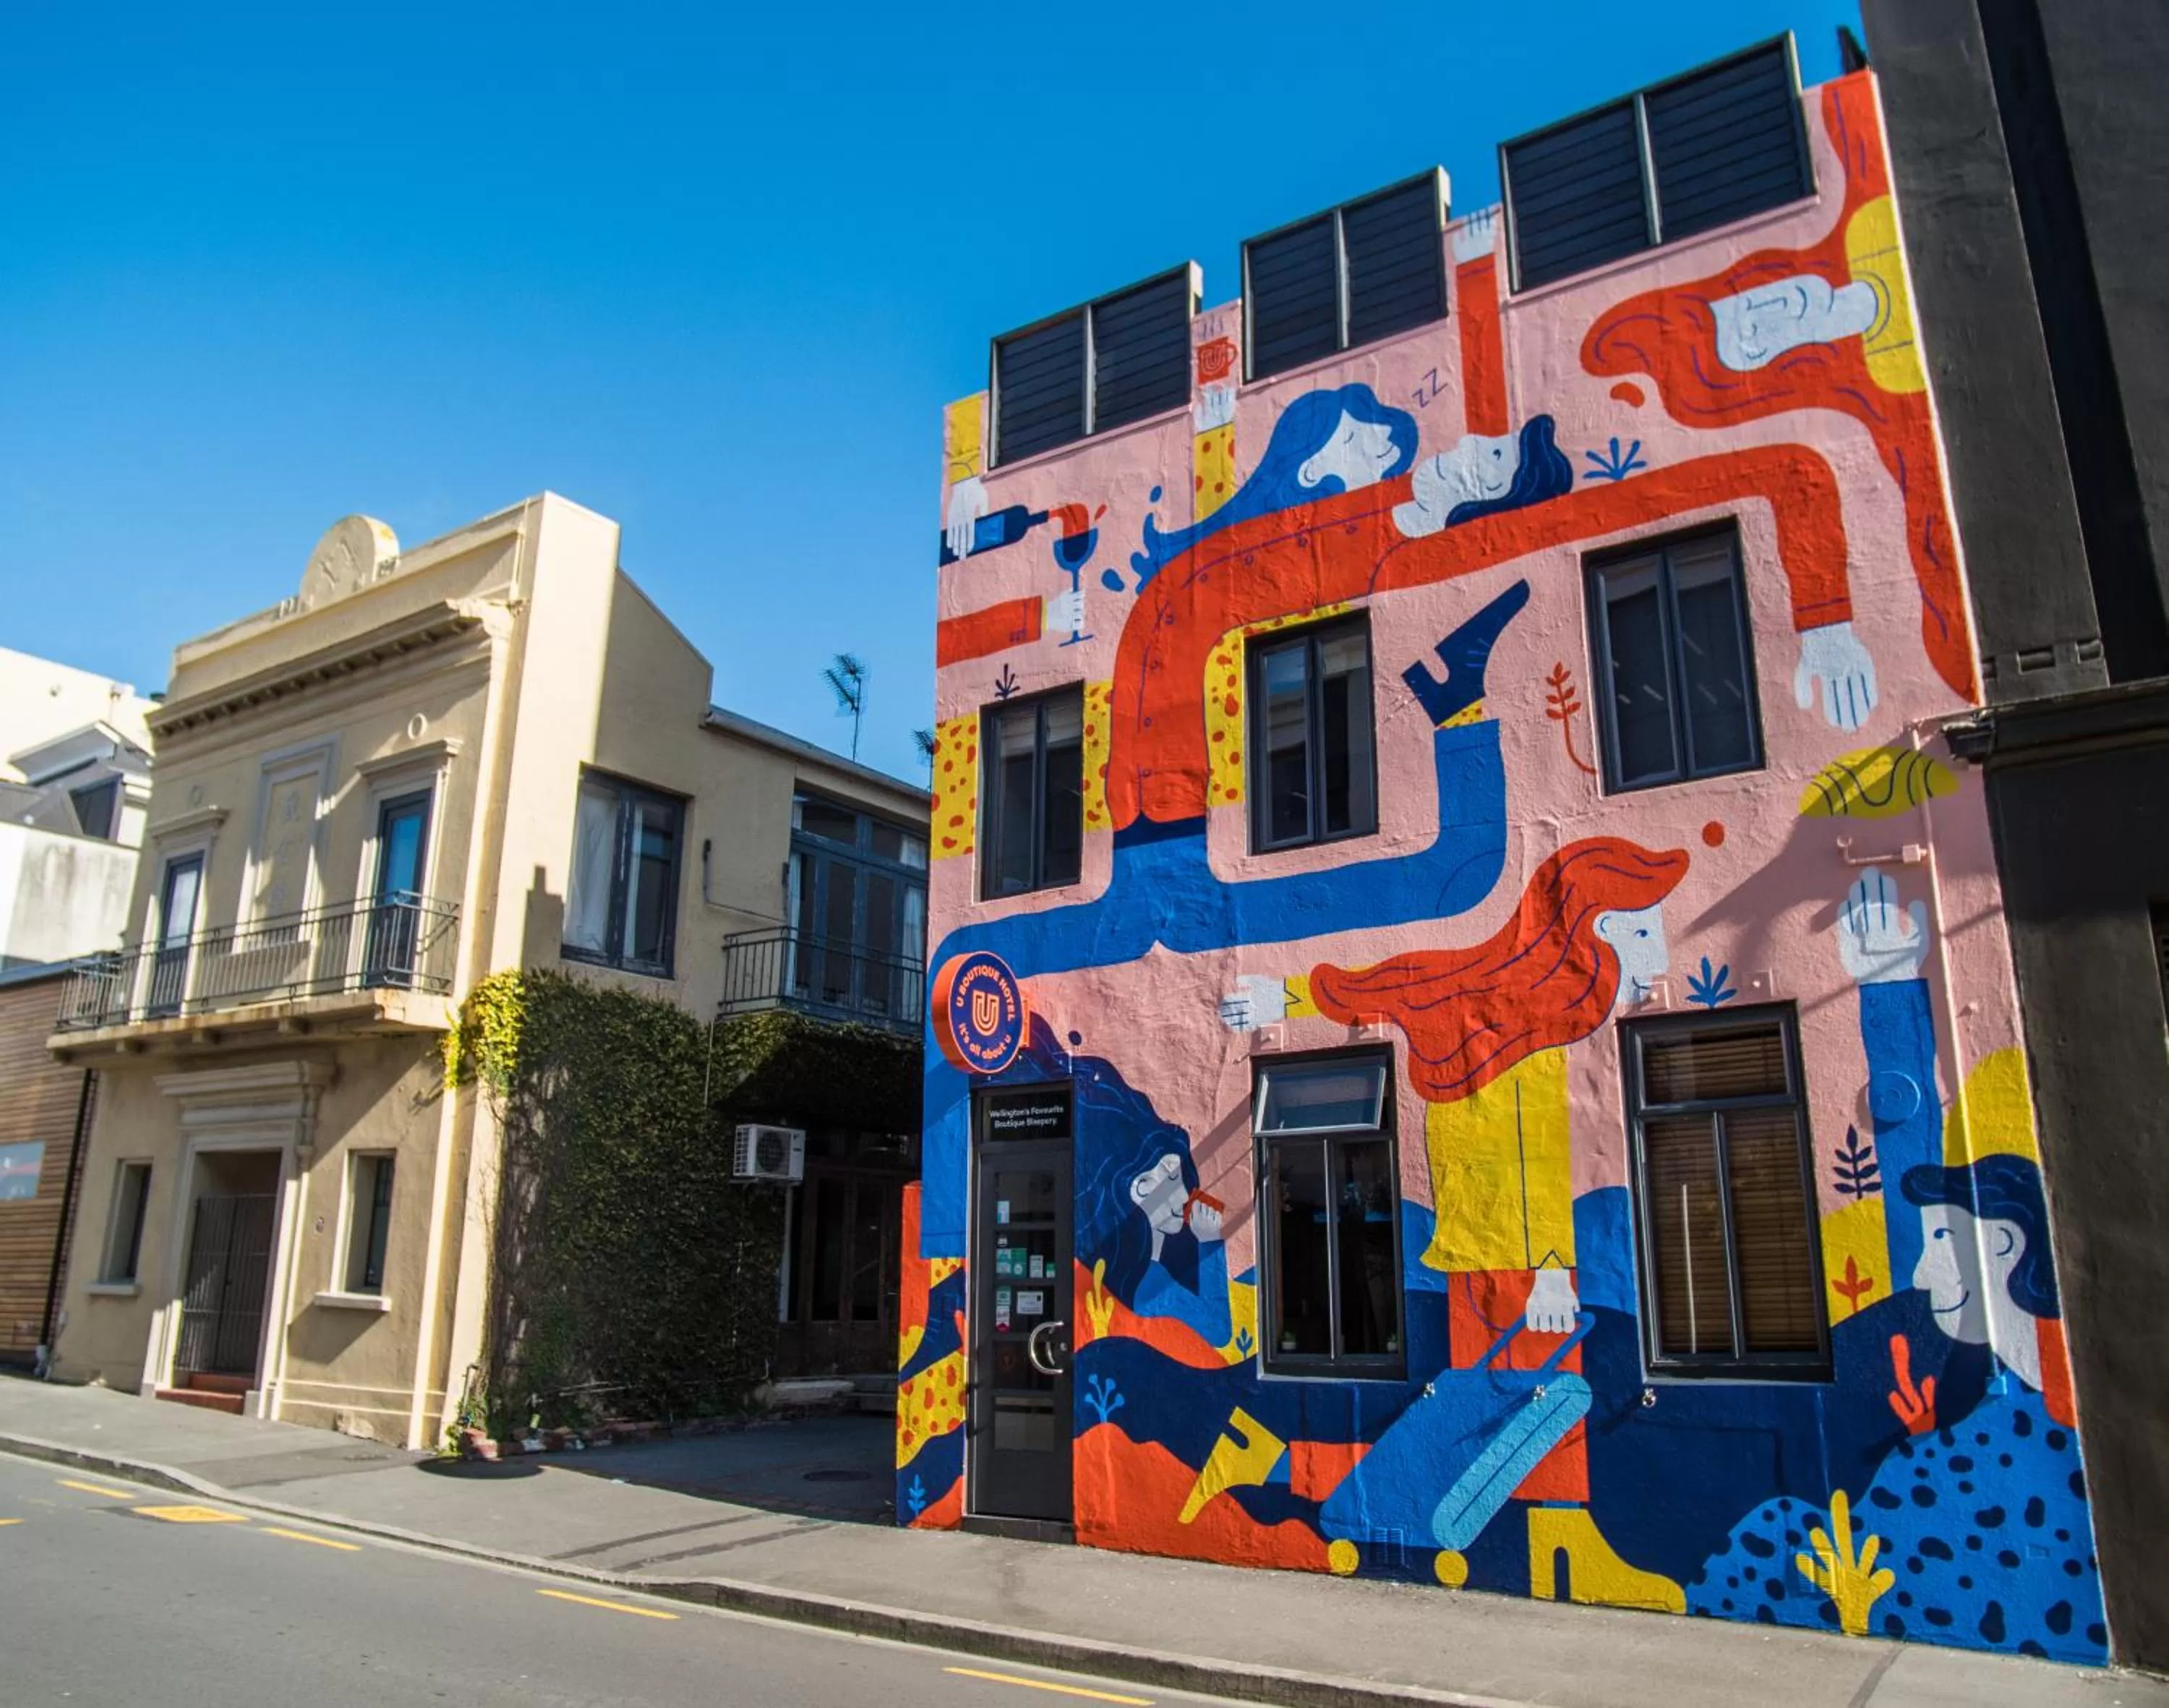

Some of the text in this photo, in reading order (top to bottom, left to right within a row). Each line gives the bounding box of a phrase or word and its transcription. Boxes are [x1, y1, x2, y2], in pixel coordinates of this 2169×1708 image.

[955, 965, 1015, 1022] U BOUTIQUE HOTEL
[970, 1043, 981, 1056] all
[981, 1041, 1007, 1059] about
[988, 1108, 1030, 1119] Wellington's
[994, 1119, 1025, 1128] Boutique
